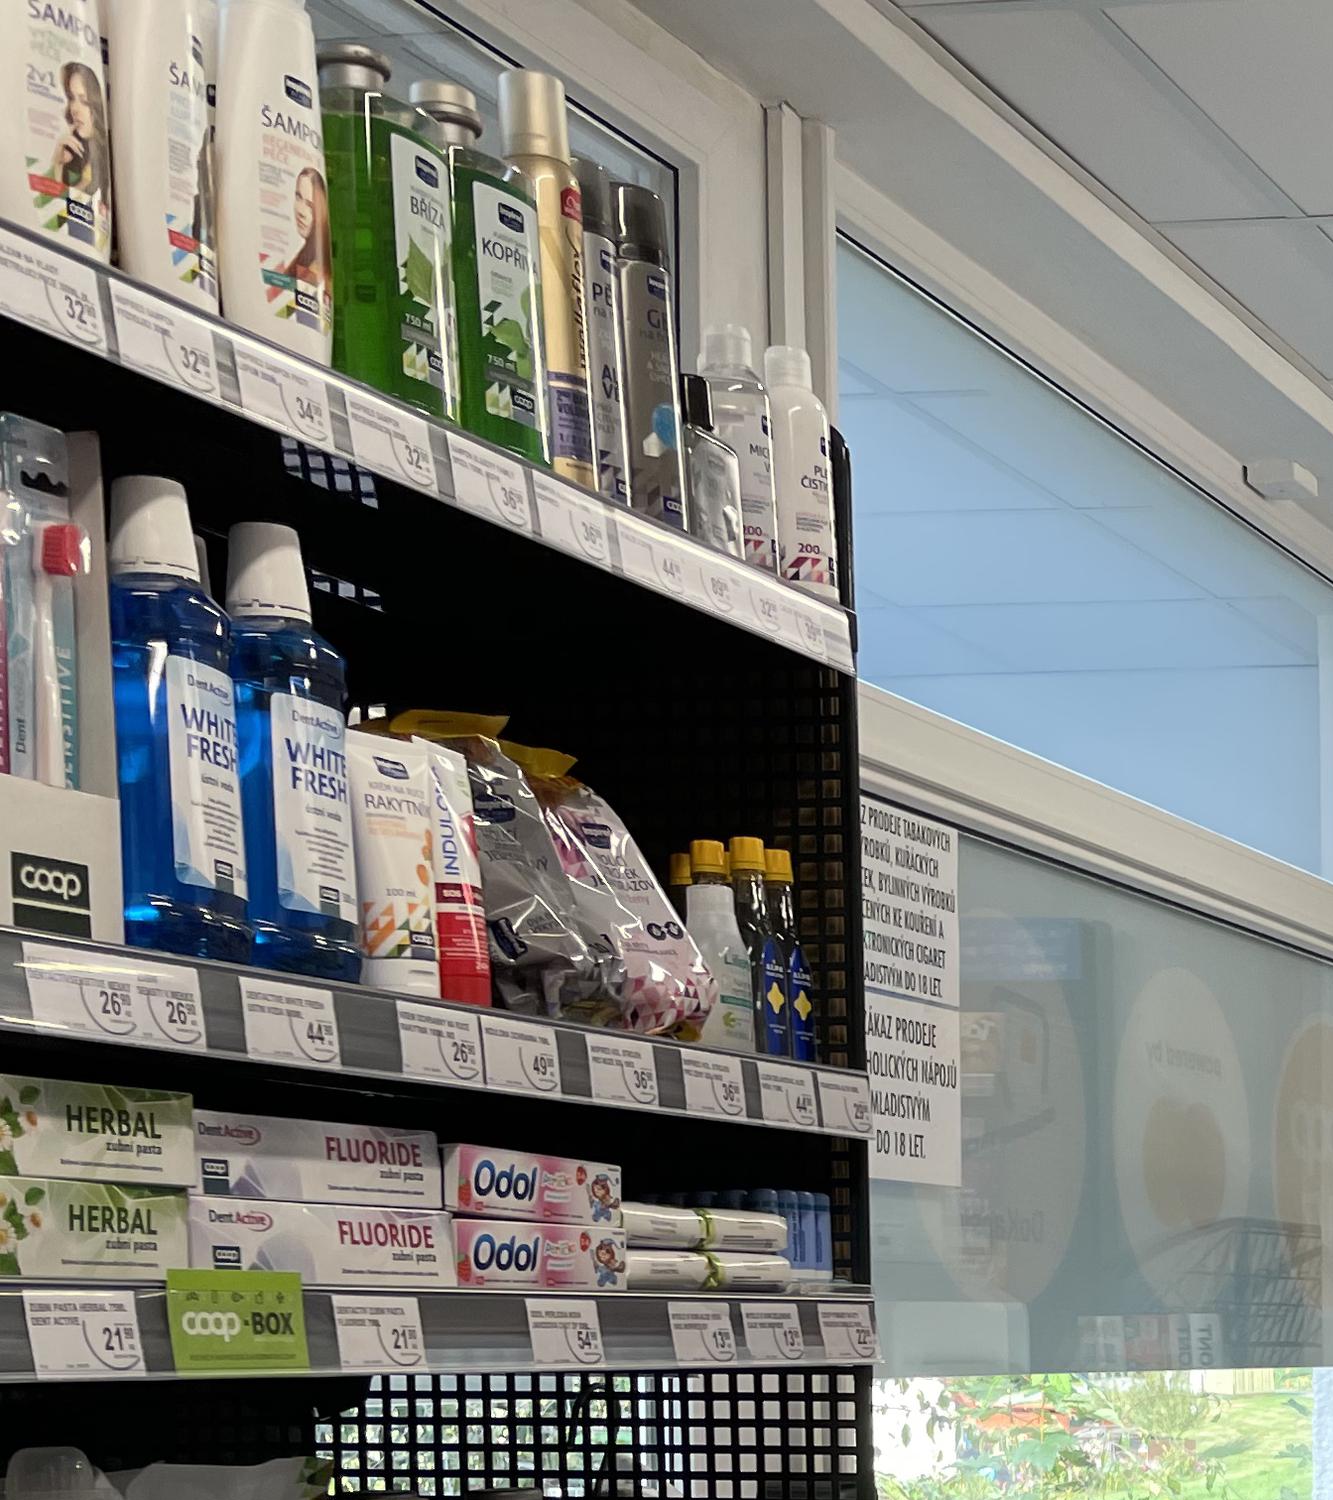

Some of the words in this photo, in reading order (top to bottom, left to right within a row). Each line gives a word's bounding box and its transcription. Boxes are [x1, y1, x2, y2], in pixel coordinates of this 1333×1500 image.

[285, 737, 347, 779] WHITE
[292, 766, 348, 806] FRESH
[868, 806, 901, 837] PRODEJE
[903, 818, 951, 853] TABÁKOVÝCH
[20, 865, 81, 901] coop
[921, 883, 956, 914] VÝROBKŮ
[939, 920, 945, 940] A
[916, 943, 946, 969] CIGARET
[904, 970, 916, 992] DO
[918, 974, 929, 995] 18
[895, 1016, 937, 1049] PRODEJE
[921, 1055, 957, 1089] NÁPOJŮ
[66, 1104, 162, 1139] HERBAL
[870, 1091, 931, 1122] MLADISTVÝM
[198, 1121, 258, 1142] DentActive
[876, 1129, 890, 1154] DO
[894, 1131, 905, 1157] 18
[325, 1136, 423, 1168] FLUORIDE
[473, 1159, 538, 1201] Odol
[69, 1204, 158, 1236] HERBAL
[209, 1209, 270, 1230] DentActive
[338, 1219, 434, 1249] FLUORIDE
[473, 1234, 541, 1272] Odol
